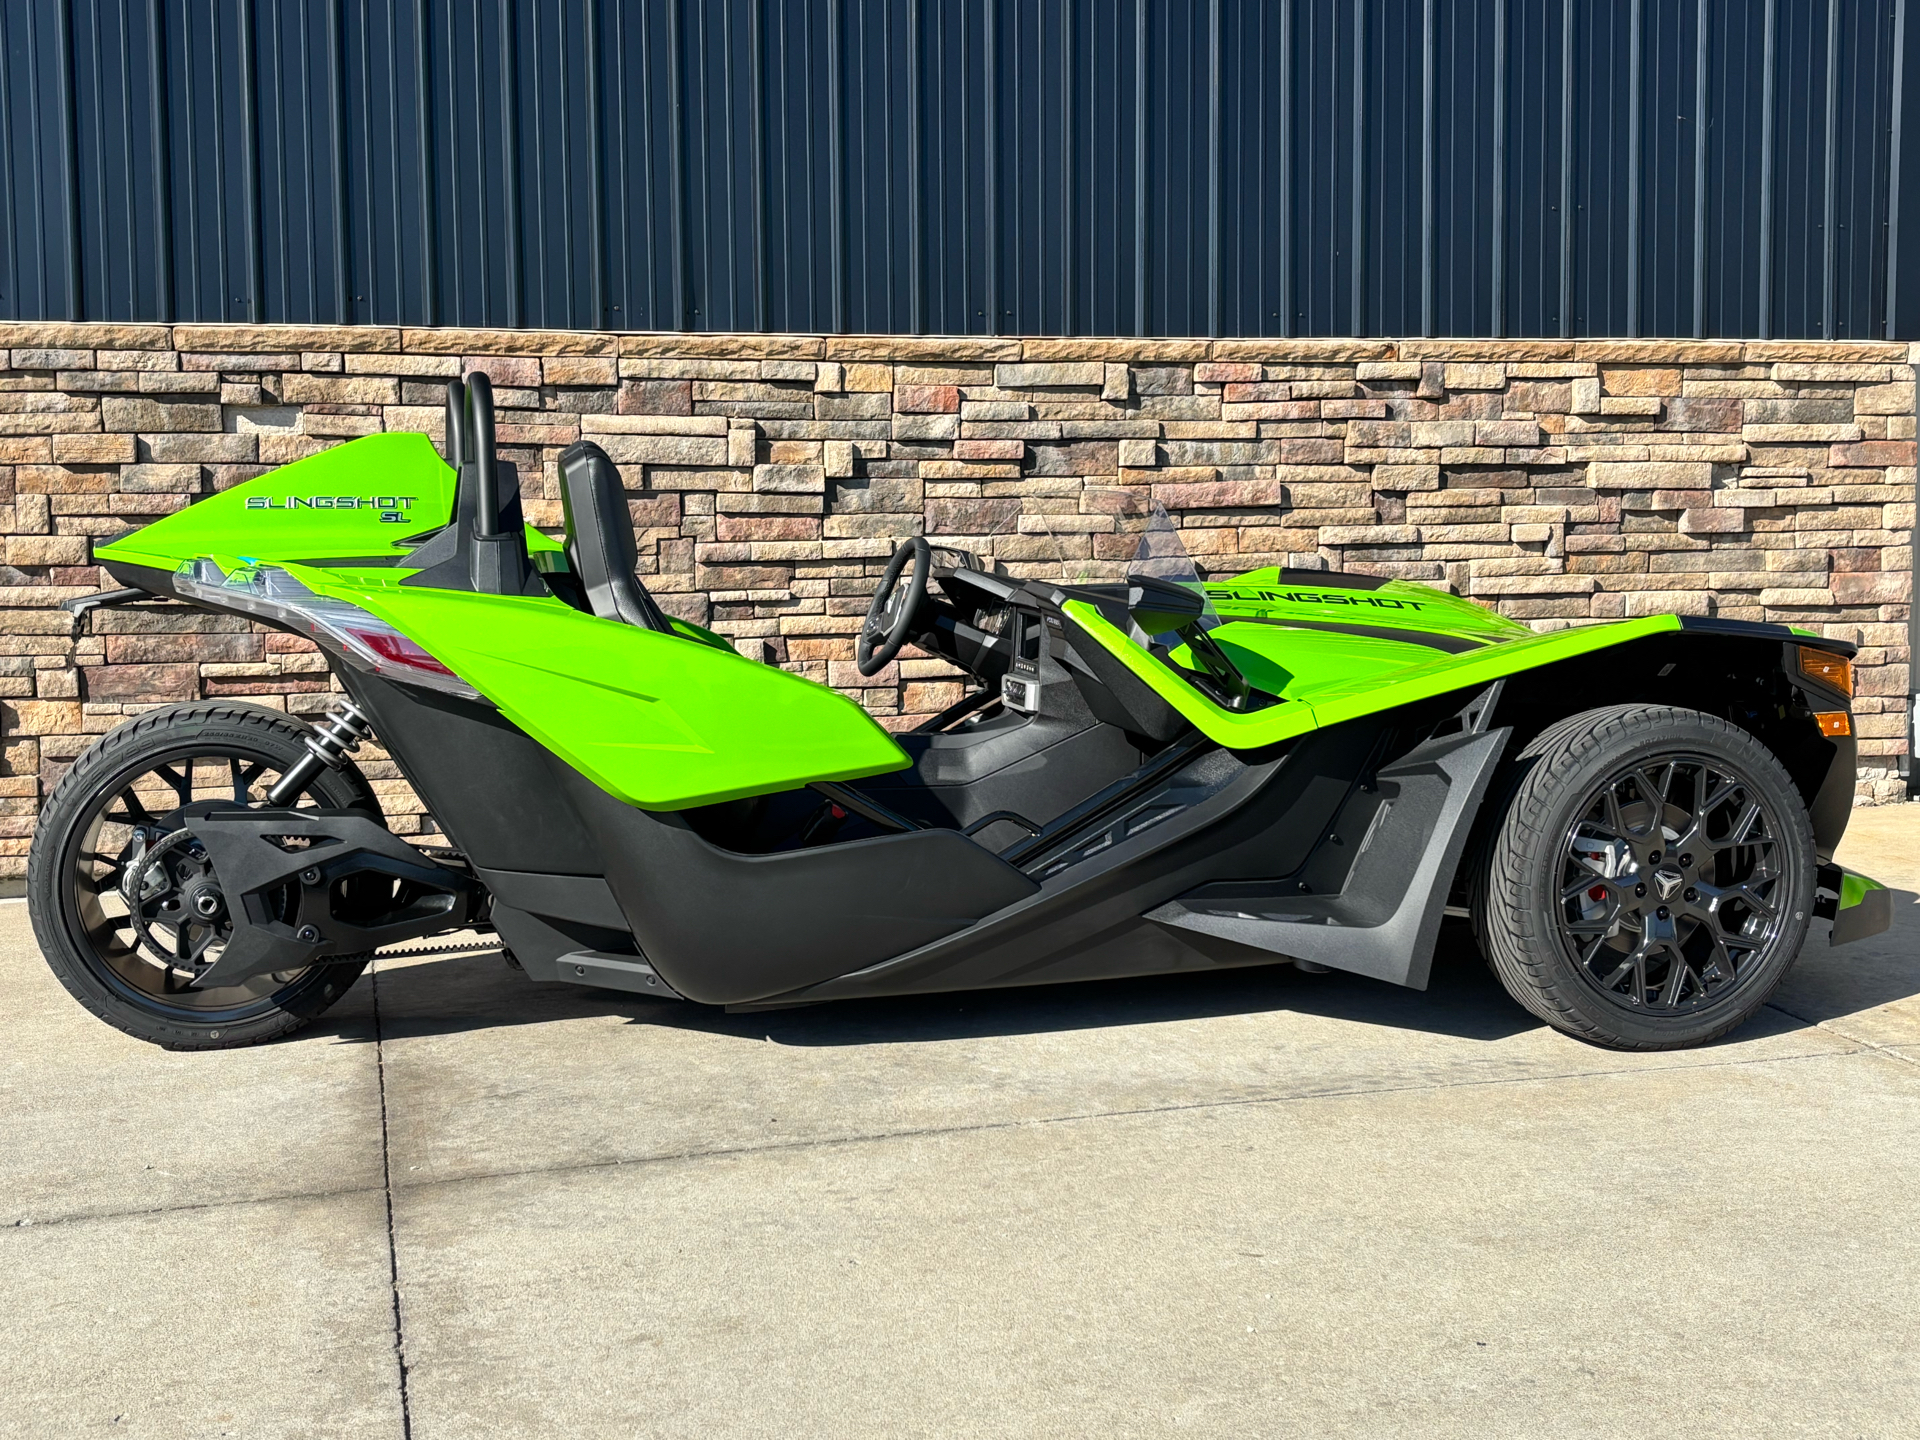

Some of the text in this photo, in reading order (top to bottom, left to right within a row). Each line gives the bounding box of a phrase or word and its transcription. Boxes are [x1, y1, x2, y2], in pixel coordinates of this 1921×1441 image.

[245, 496, 419, 510] SLINGSHOT
[379, 511, 411, 523] SL
[1206, 590, 1426, 611] SLINGSHOT
[1709, 731, 1776, 783] KENDA
